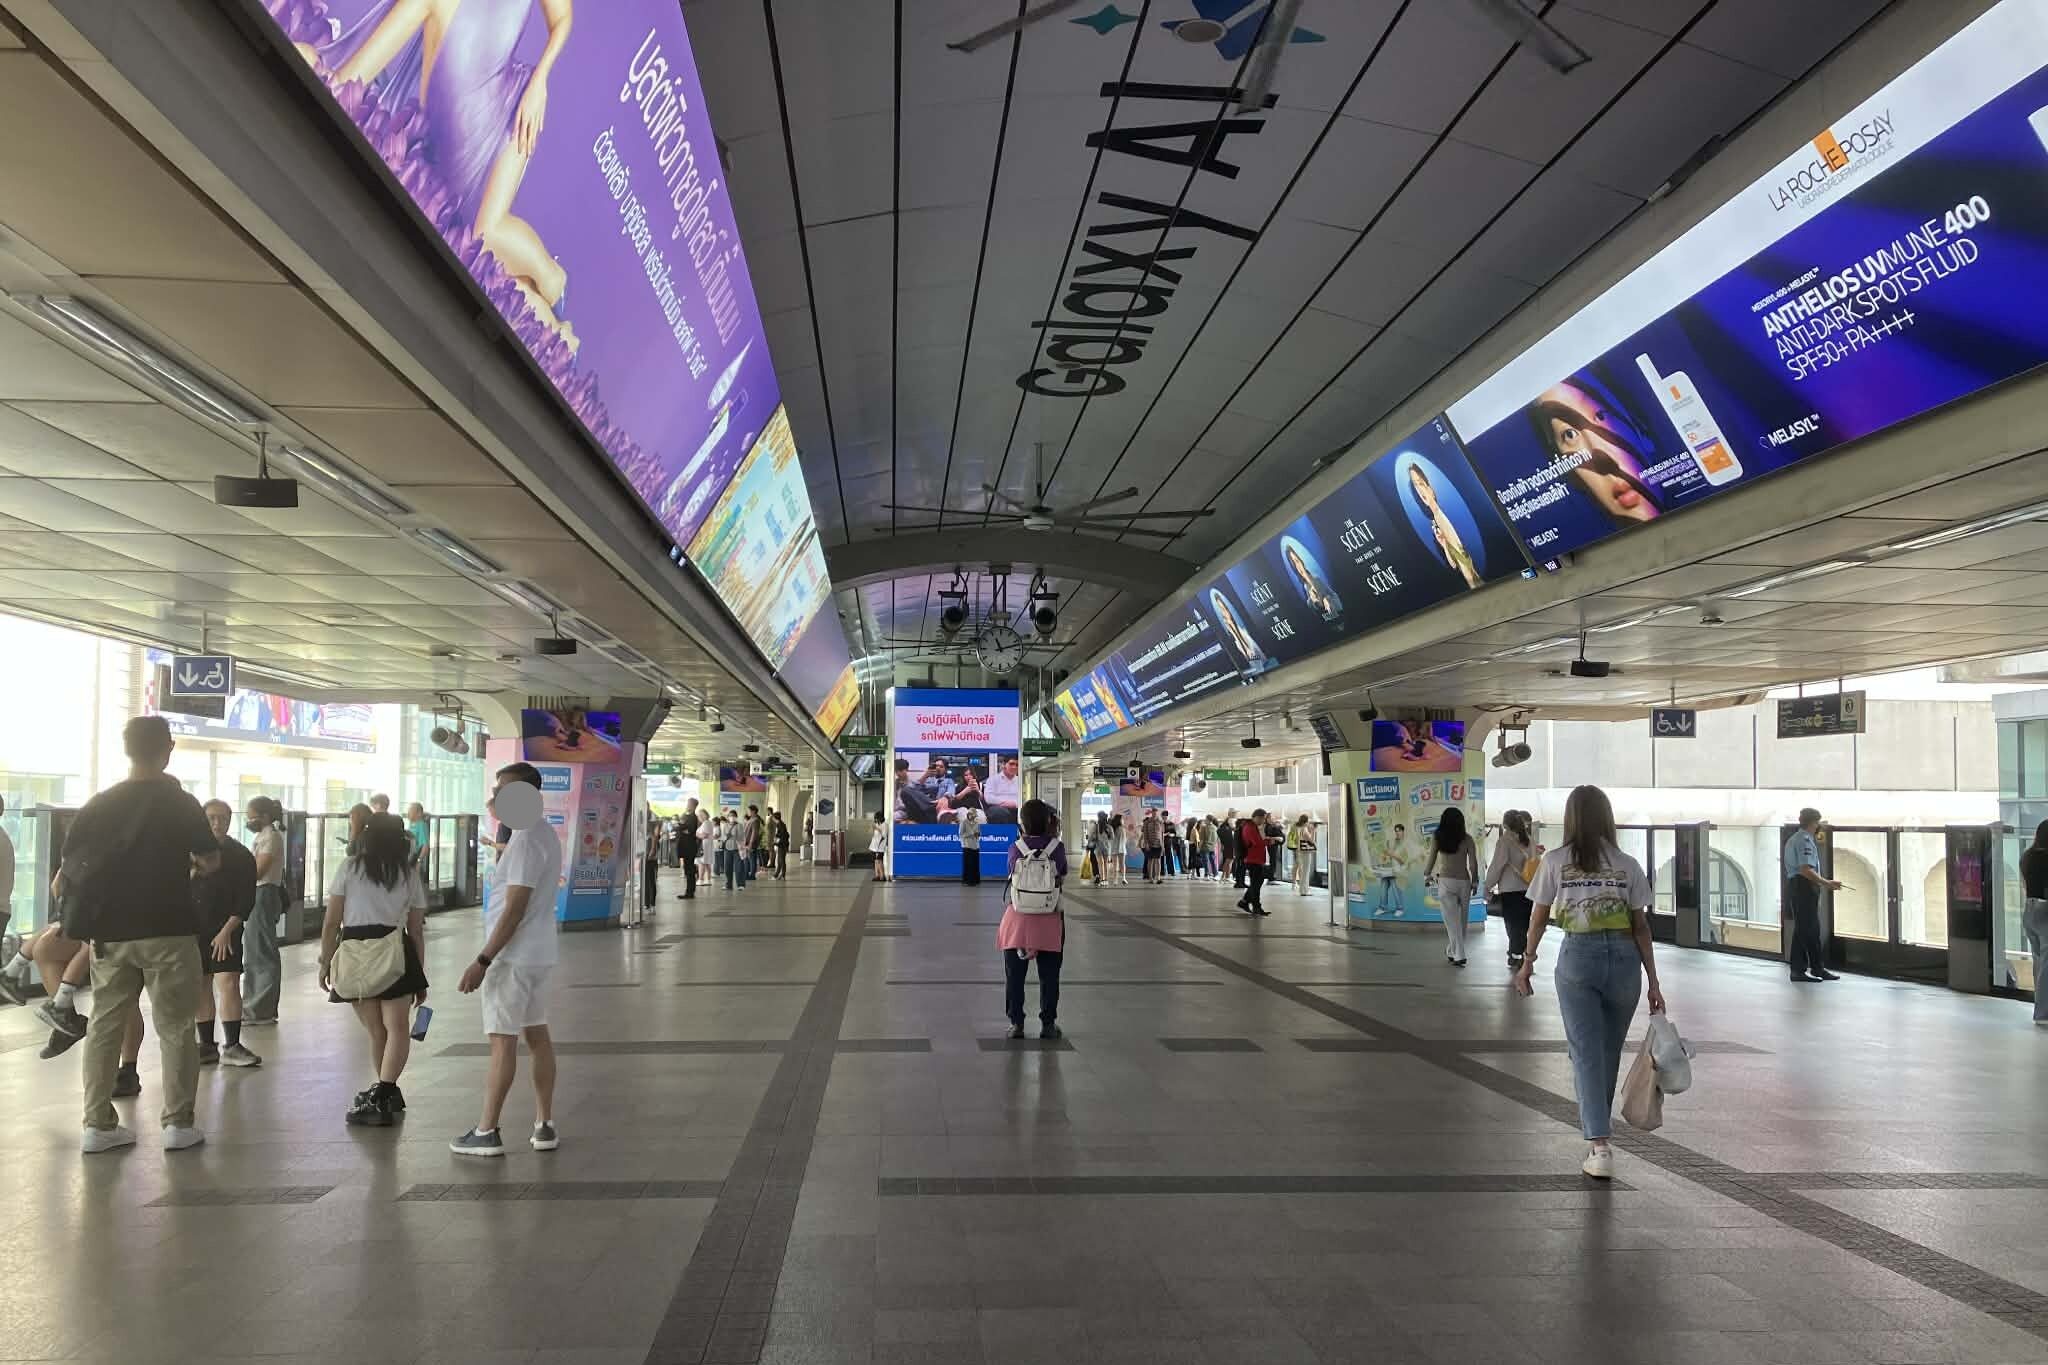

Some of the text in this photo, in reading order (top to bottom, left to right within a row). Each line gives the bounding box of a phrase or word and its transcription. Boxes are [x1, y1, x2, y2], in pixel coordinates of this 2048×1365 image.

[1768, 108, 1896, 212] LA ROCHE POSAY
[1015, 81, 1281, 398] Galaxy AI
[1761, 194, 1991, 339] ANTHELIOS UVMUNE 400
[1774, 237, 1980, 360] ANTI-DARK SPOTS FLUID
[1775, 286, 1789, 299] 400
[1785, 307, 1916, 382] SPF50+ PA++++
[1496, 477, 1532, 505] ป้องกันฝ้า
[1339, 519, 1375, 553] SCENT
[1249, 582, 1274, 608] SCENT
[1366, 565, 1403, 596] SCENE
[1270, 618, 1296, 641] SCENE
[920, 729, 991, 742] รถไฟฟ้าบีทีเอส
[1561, 880, 1627, 889] BOWLING CLUB
